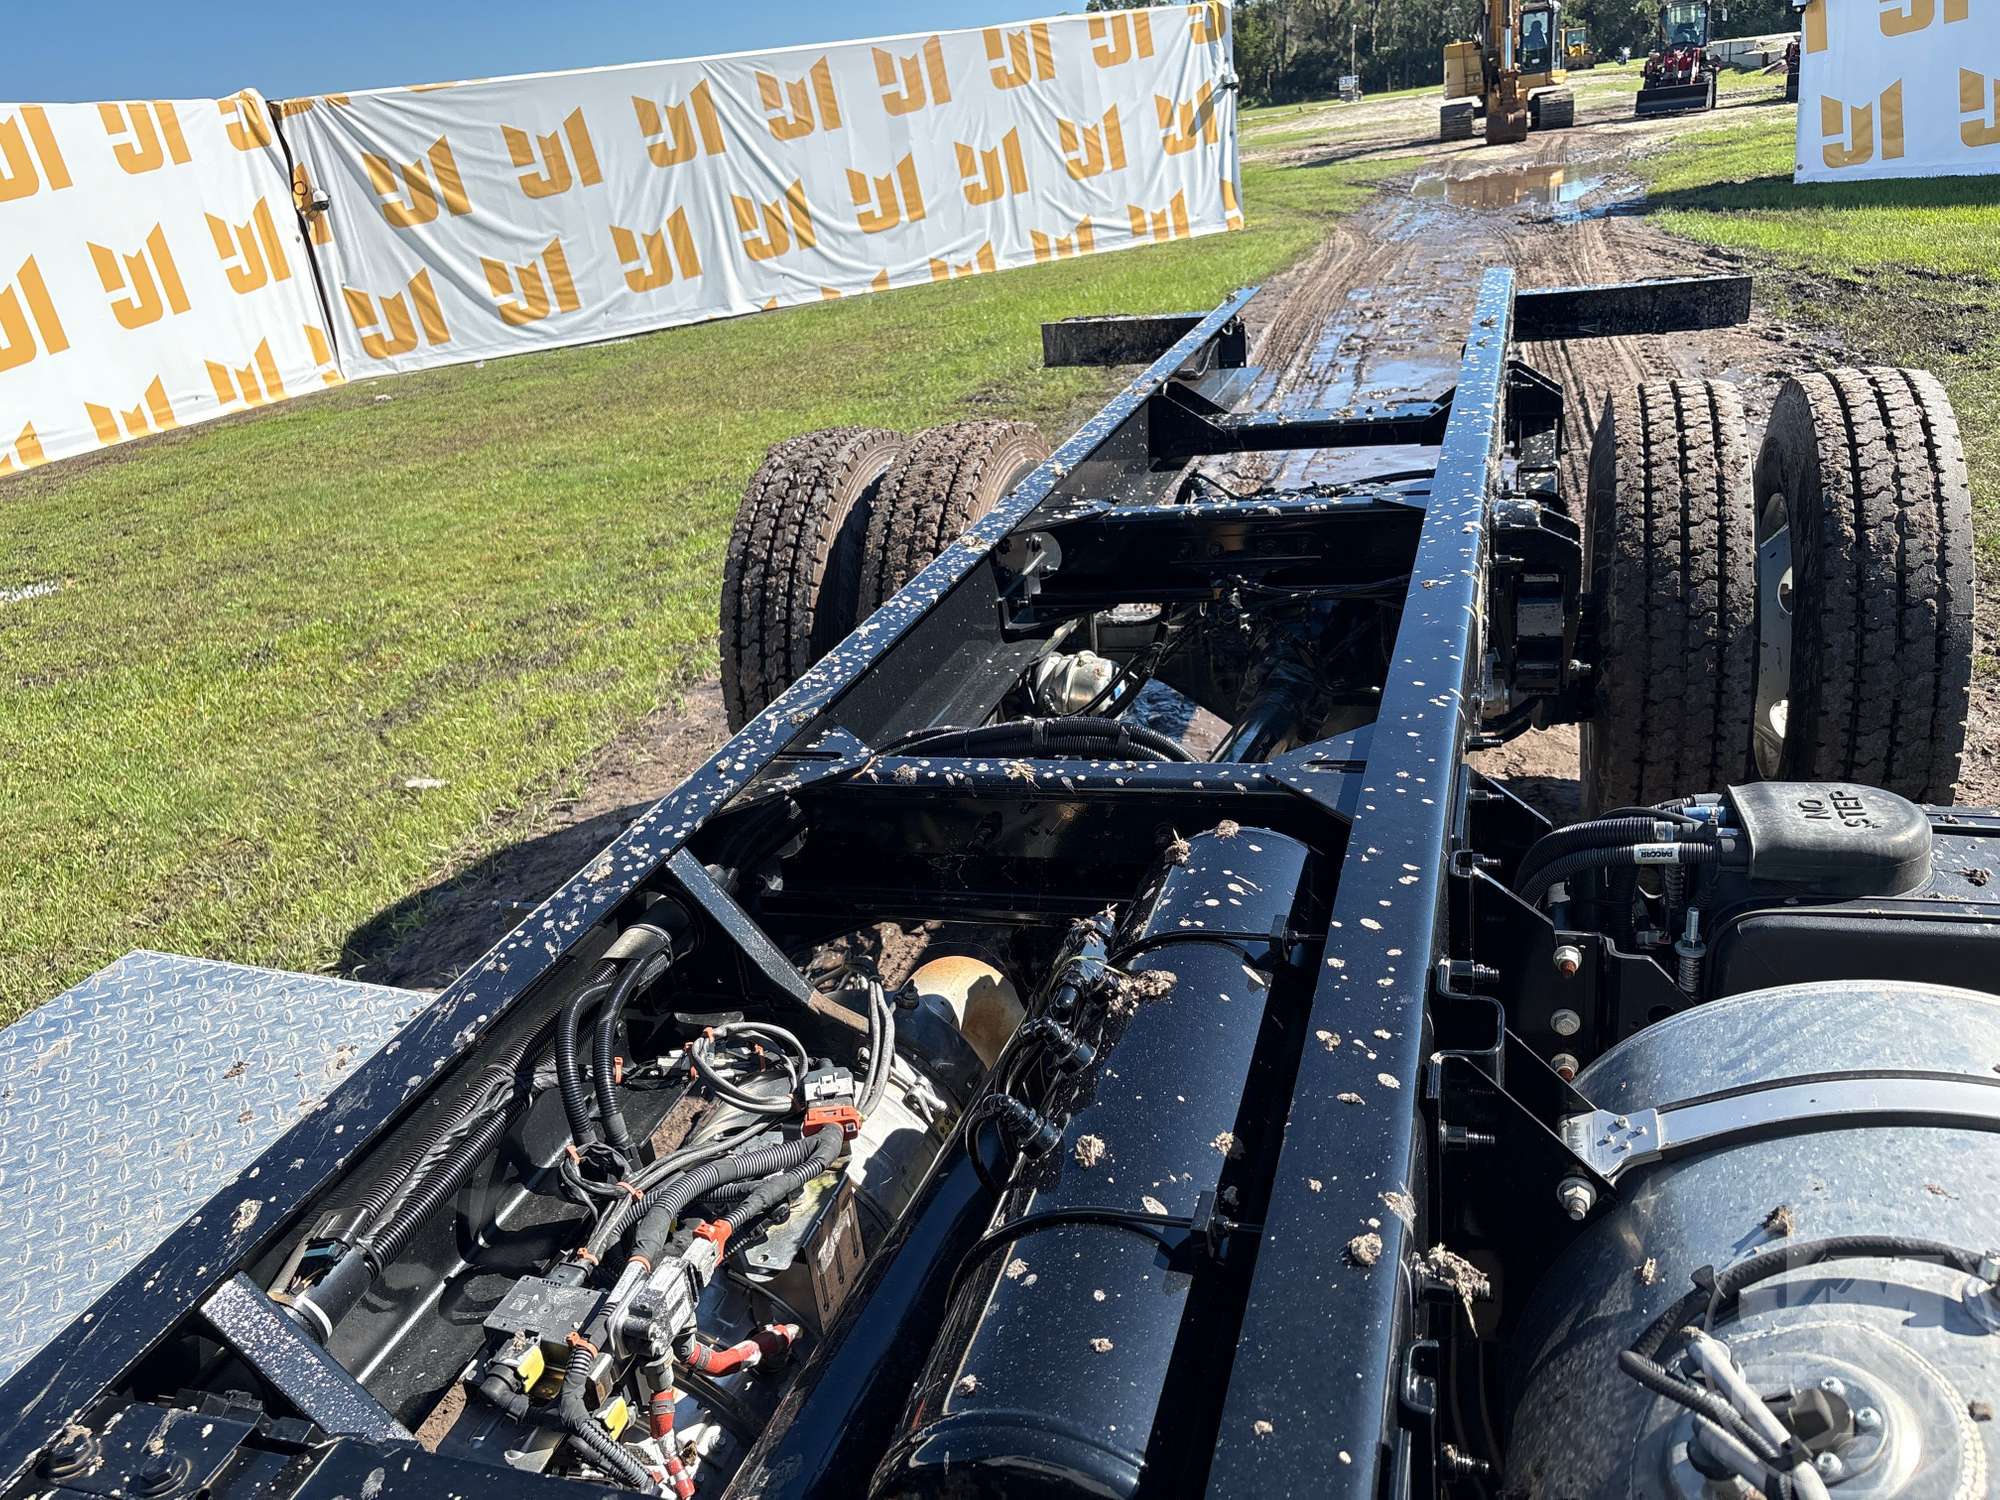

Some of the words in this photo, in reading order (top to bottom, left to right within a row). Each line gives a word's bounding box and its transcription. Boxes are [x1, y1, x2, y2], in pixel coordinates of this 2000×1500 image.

[1798, 799, 1832, 819] NO
[1829, 790, 1872, 828] STEP
[1640, 850, 1673, 858] PACCAR
